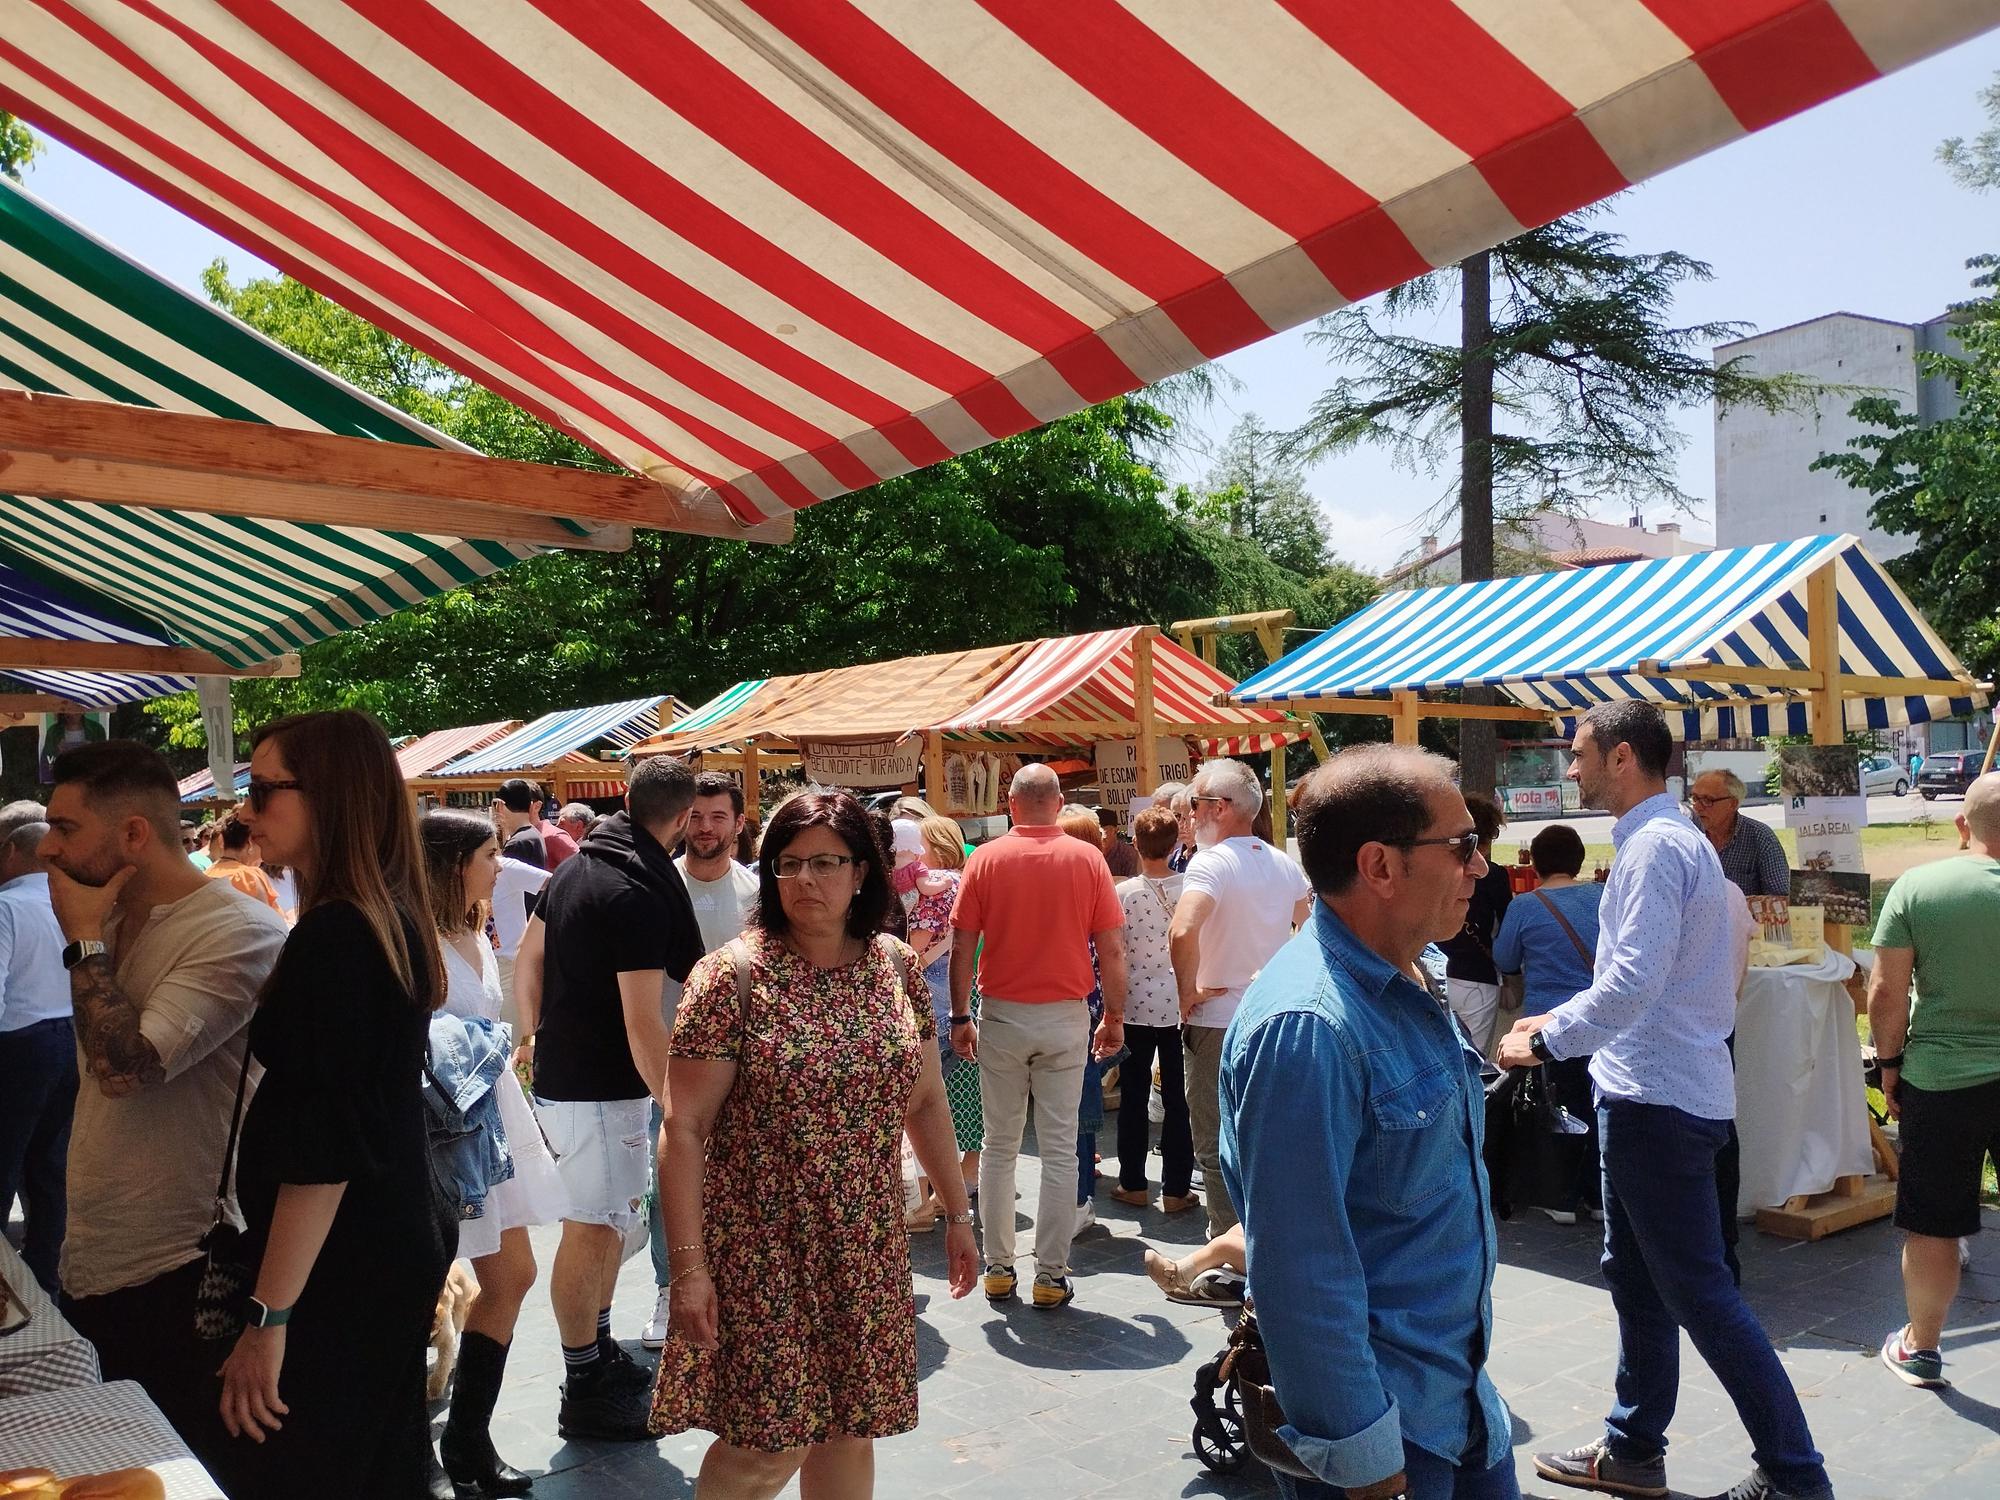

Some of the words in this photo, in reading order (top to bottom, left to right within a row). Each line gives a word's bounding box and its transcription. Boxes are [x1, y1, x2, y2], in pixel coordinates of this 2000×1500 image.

[1099, 767, 1109, 784] DE
[1111, 766, 1138, 784] ESCAN
[1159, 763, 1189, 781] TRIGO
[1515, 790, 1542, 804] vota
